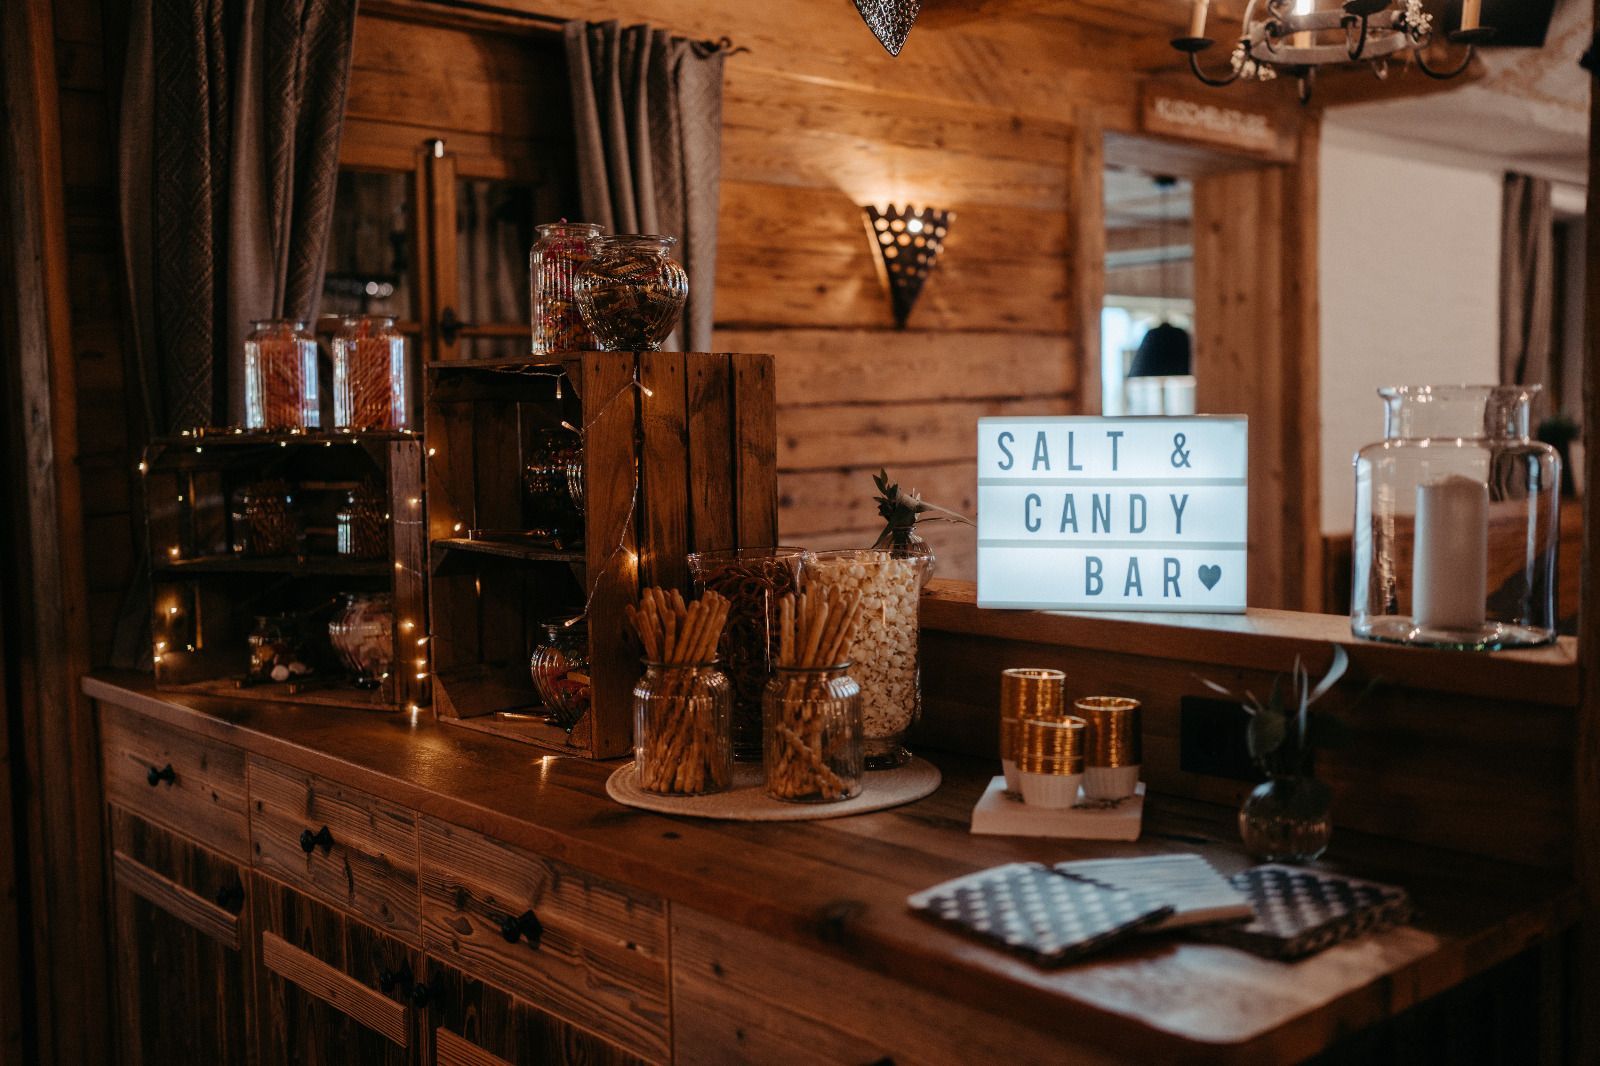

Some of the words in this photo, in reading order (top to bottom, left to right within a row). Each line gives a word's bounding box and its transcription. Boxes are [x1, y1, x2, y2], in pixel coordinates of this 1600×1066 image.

[997, 431, 1124, 471] SALT
[1170, 432, 1192, 468] &
[1024, 493, 1189, 534] CANDY
[1085, 556, 1182, 597] BAR
